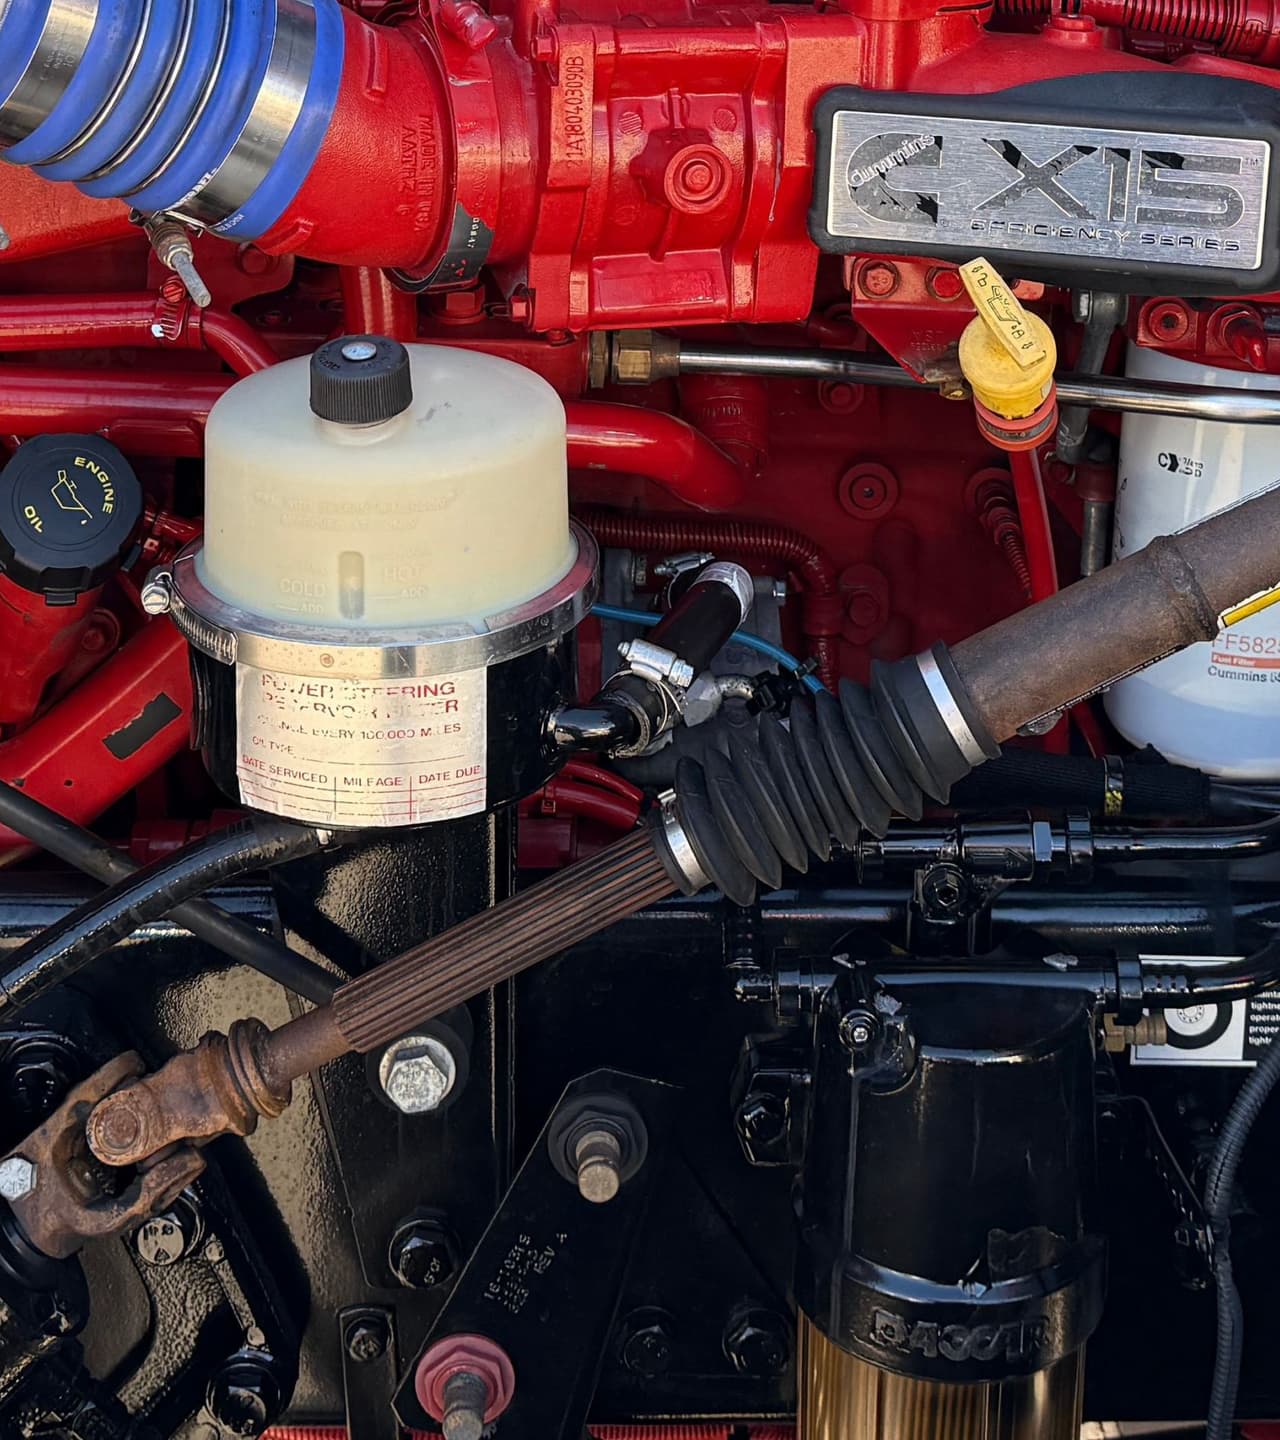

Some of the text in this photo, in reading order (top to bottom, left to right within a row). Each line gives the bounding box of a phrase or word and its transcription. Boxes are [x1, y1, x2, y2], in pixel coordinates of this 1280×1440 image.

[849, 132, 937, 189] cummins
[972, 137, 1246, 229] X15
[970, 218, 1241, 252] EFFICIENCY SERIES
[73, 456, 115, 514] ENGINE
[23, 505, 43, 533] OIL
[1208, 666, 1268, 684] Cummins
[420, 723, 462, 737] MES
[242, 754, 481, 787] DATE SERVICED MILEAGE DATE DUE
[1249, 1025, 1280, 1035] proper
